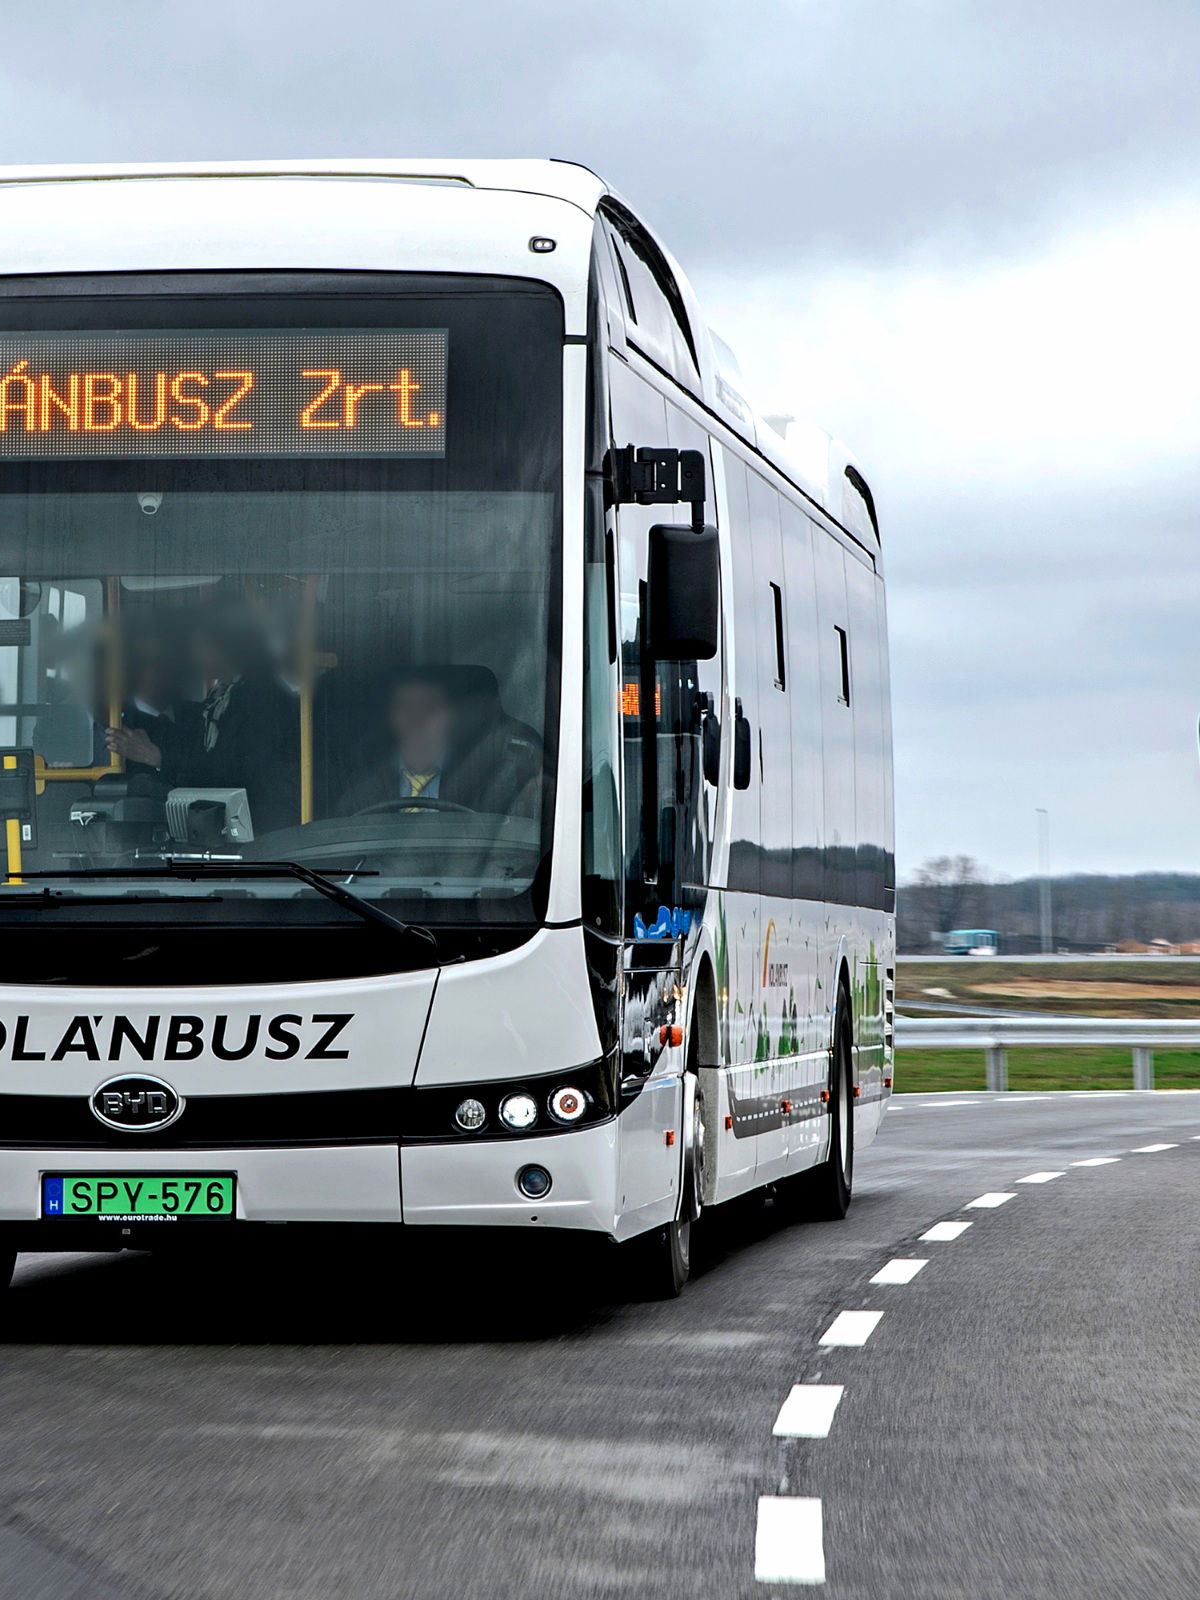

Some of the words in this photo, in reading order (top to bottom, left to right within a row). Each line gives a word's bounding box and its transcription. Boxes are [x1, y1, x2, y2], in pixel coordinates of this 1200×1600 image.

[300, 368, 442, 429] Zrt.
[102, 1091, 167, 1114] BYD
[49, 1199, 59, 1211] H
[71, 1181, 225, 1213] SPY-576
[98, 1214, 178, 1222] www.eurotrade.hu
